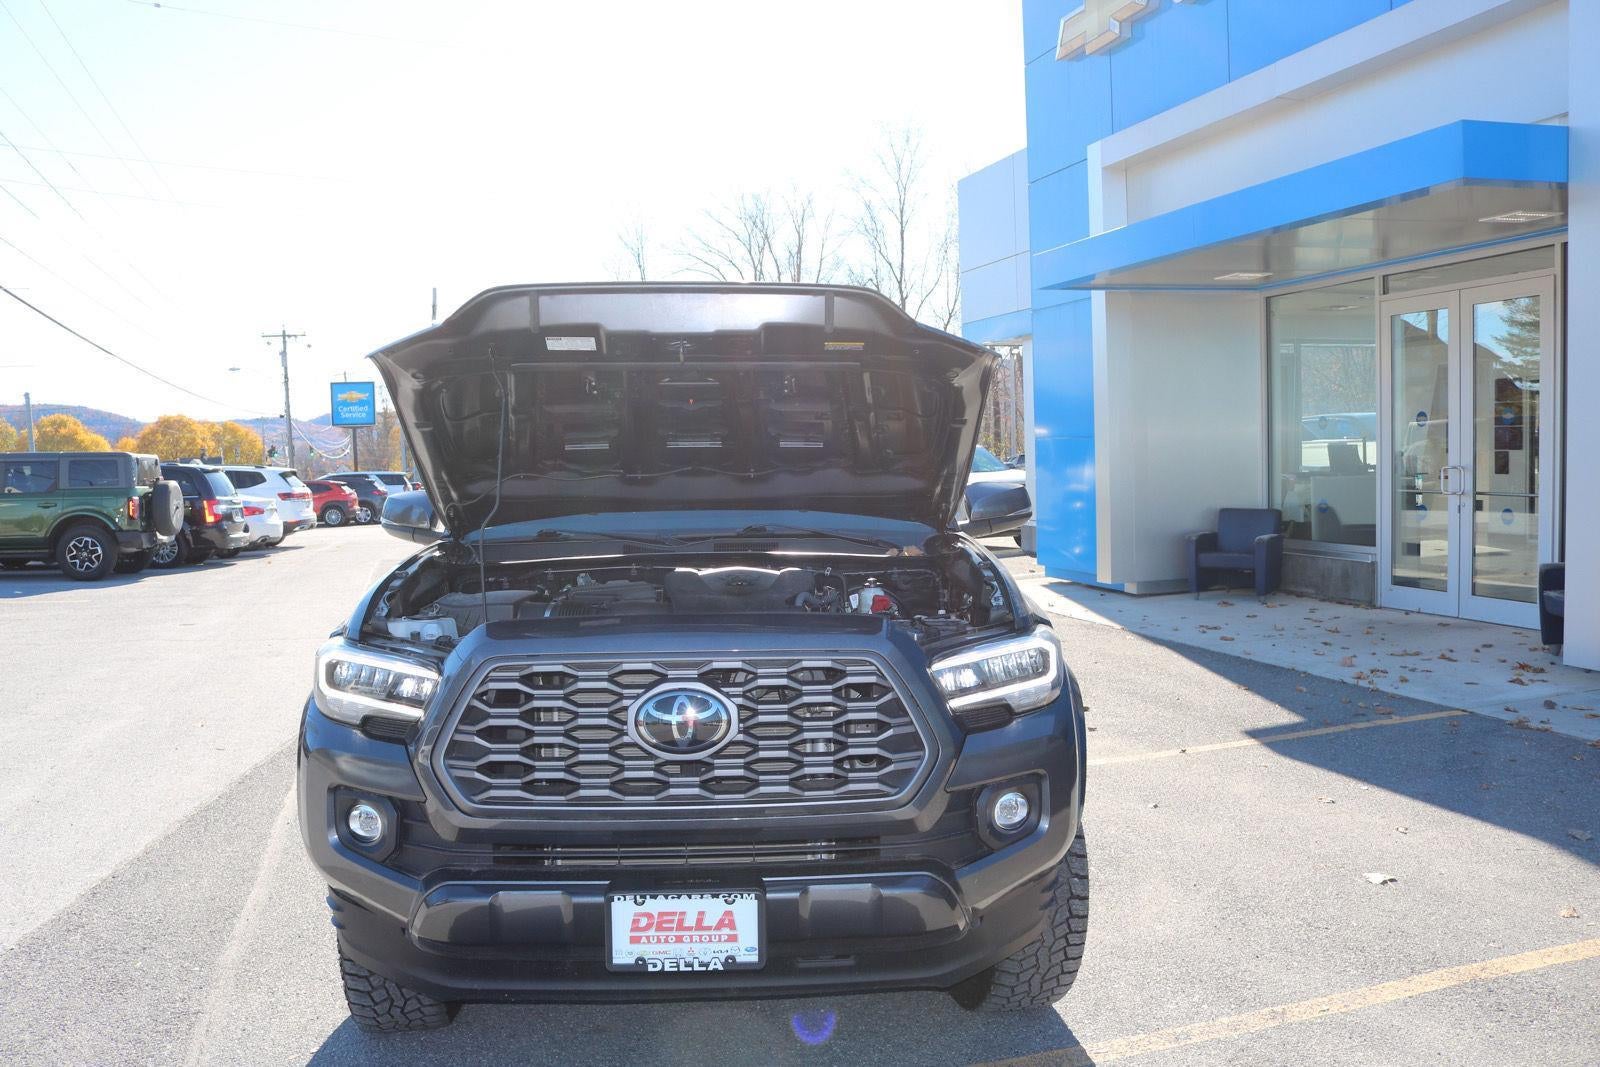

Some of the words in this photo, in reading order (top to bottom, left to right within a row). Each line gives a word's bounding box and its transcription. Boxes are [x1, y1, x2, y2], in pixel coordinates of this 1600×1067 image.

[629, 910, 737, 932] DELLA
[640, 936, 676, 944] AUTO
[682, 935, 729, 943] GROUP
[647, 957, 724, 972] DELLA
